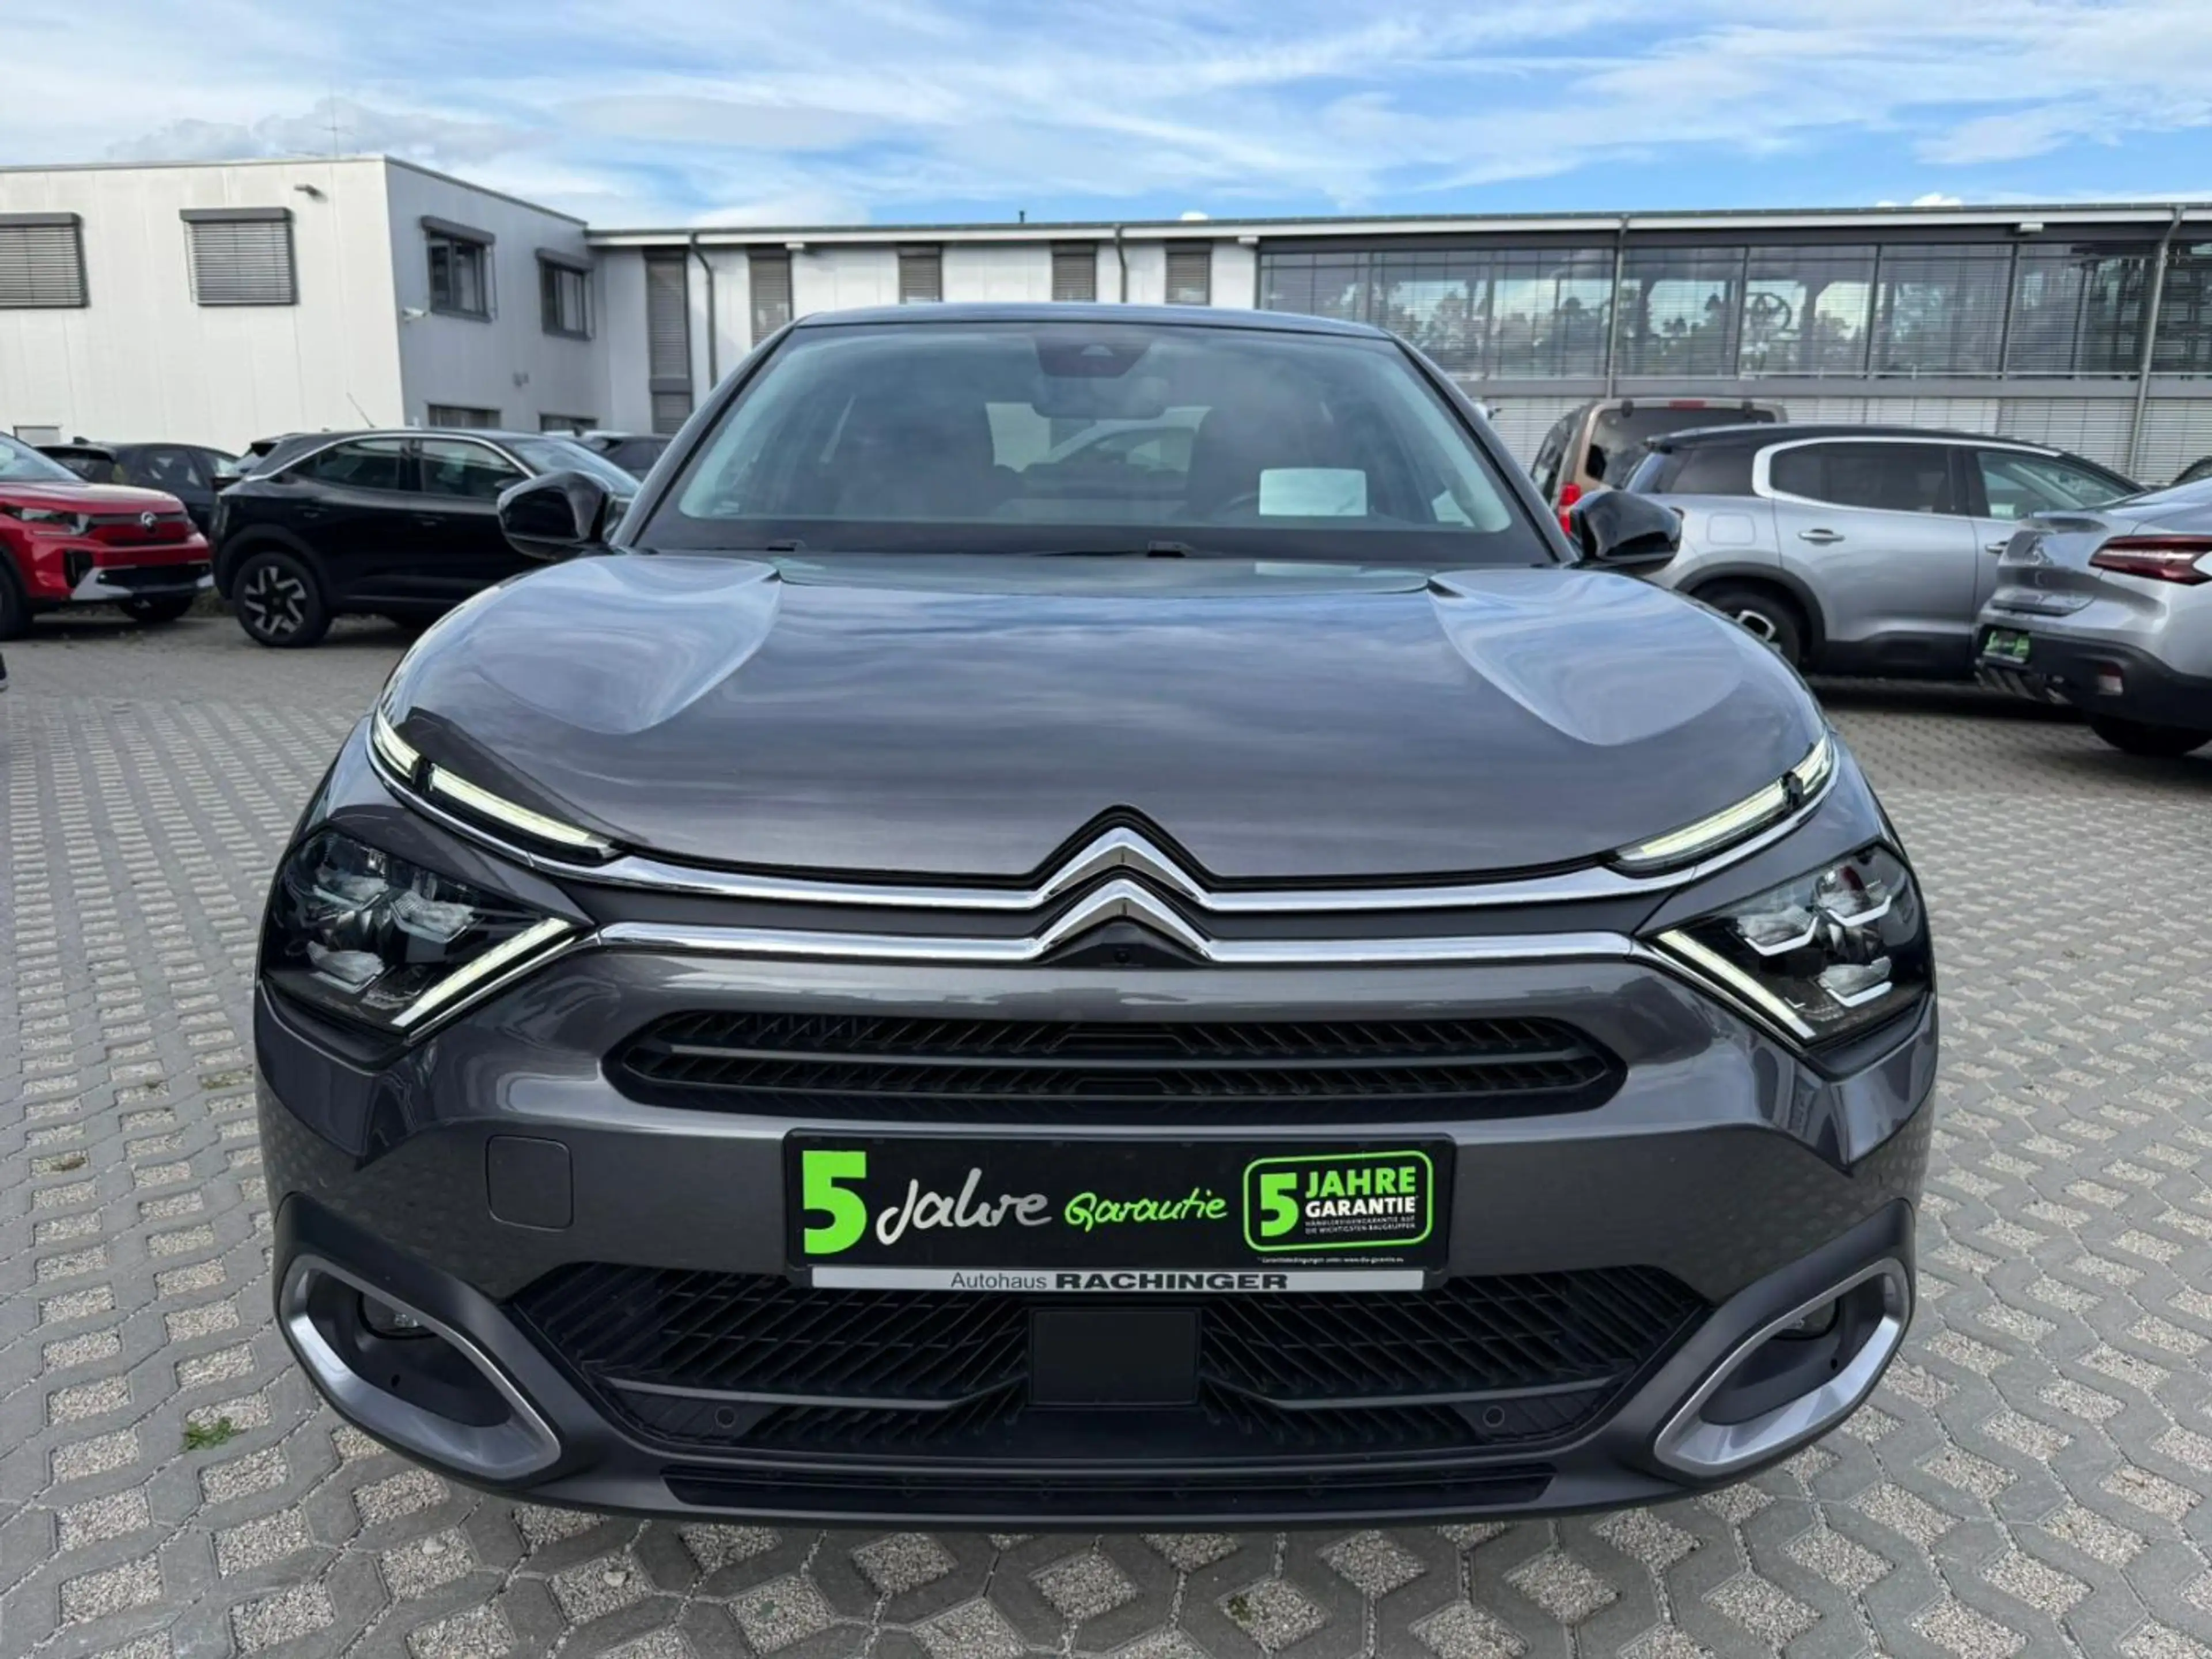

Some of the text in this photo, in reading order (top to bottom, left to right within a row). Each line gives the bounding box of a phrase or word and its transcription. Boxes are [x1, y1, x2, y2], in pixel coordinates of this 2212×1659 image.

[802, 1150, 867, 1254] 5
[876, 1167, 1053, 1245] Jahre
[1260, 1166, 1416, 1237] 5 JAHRE
[950, 1272, 1287, 1290] Autohaus RACHINGER
